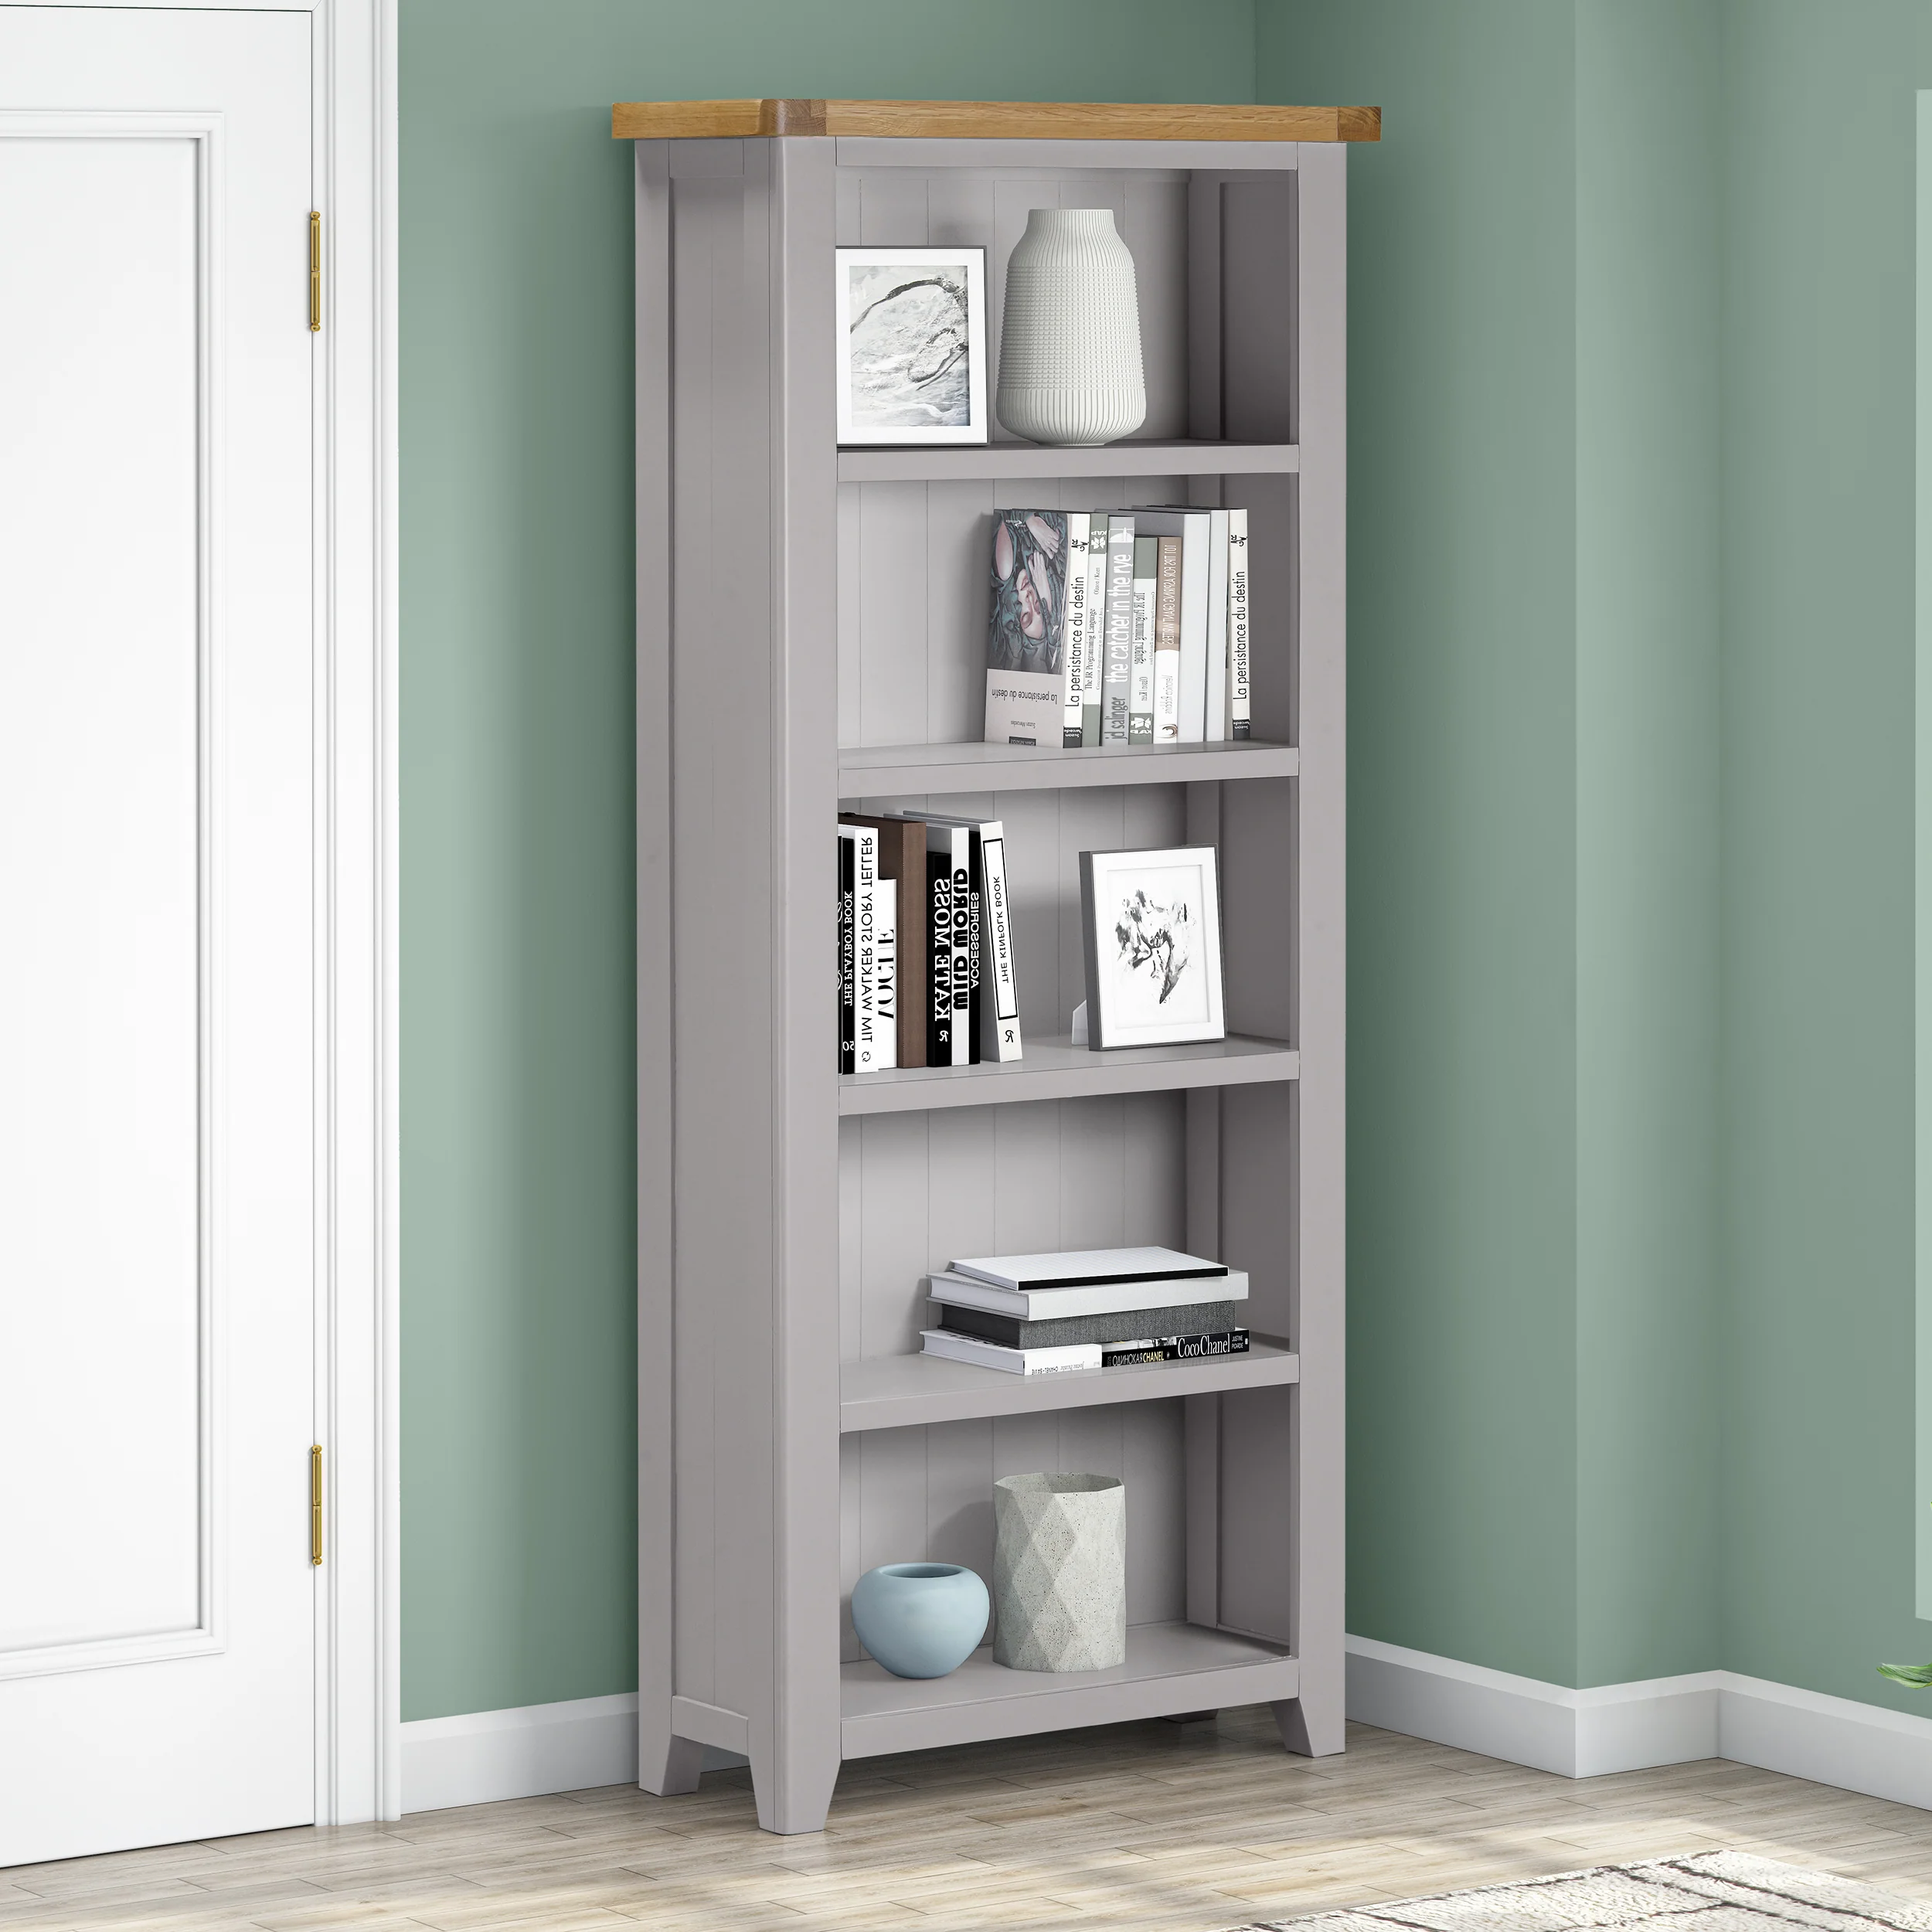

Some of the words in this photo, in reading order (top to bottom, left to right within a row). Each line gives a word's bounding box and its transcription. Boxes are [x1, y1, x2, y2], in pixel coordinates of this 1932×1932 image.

[1113, 554, 1133, 573] rye
[1070, 577, 1083, 608] destin
[1107, 577, 1130, 597] the
[1232, 571, 1246, 603] destin
[1107, 600, 1130, 611] in
[1232, 607, 1246, 620] du
[1068, 614, 1083, 626] du
[1087, 608, 1097, 634] Language
[1105, 614, 1130, 659] catcher
[1067, 630, 1083, 691] persistance
[1233, 624, 1250, 684] persistance
[1104, 663, 1128, 683] the
[992, 689, 1009, 700] destin
[1009, 690, 1017, 702] du
[1019, 691, 1049, 702] persistance
[1051, 694, 1057, 705] La
[1065, 696, 1080, 706] La
[1233, 688, 1247, 699] La
[1104, 697, 1128, 729] salinger
[1104, 731, 1128, 740] jd
[1178, 1338, 1199, 1357] Coco
[1199, 1333, 1230, 1355] Chanel
[1143, 1351, 1164, 1363] CHANEL
